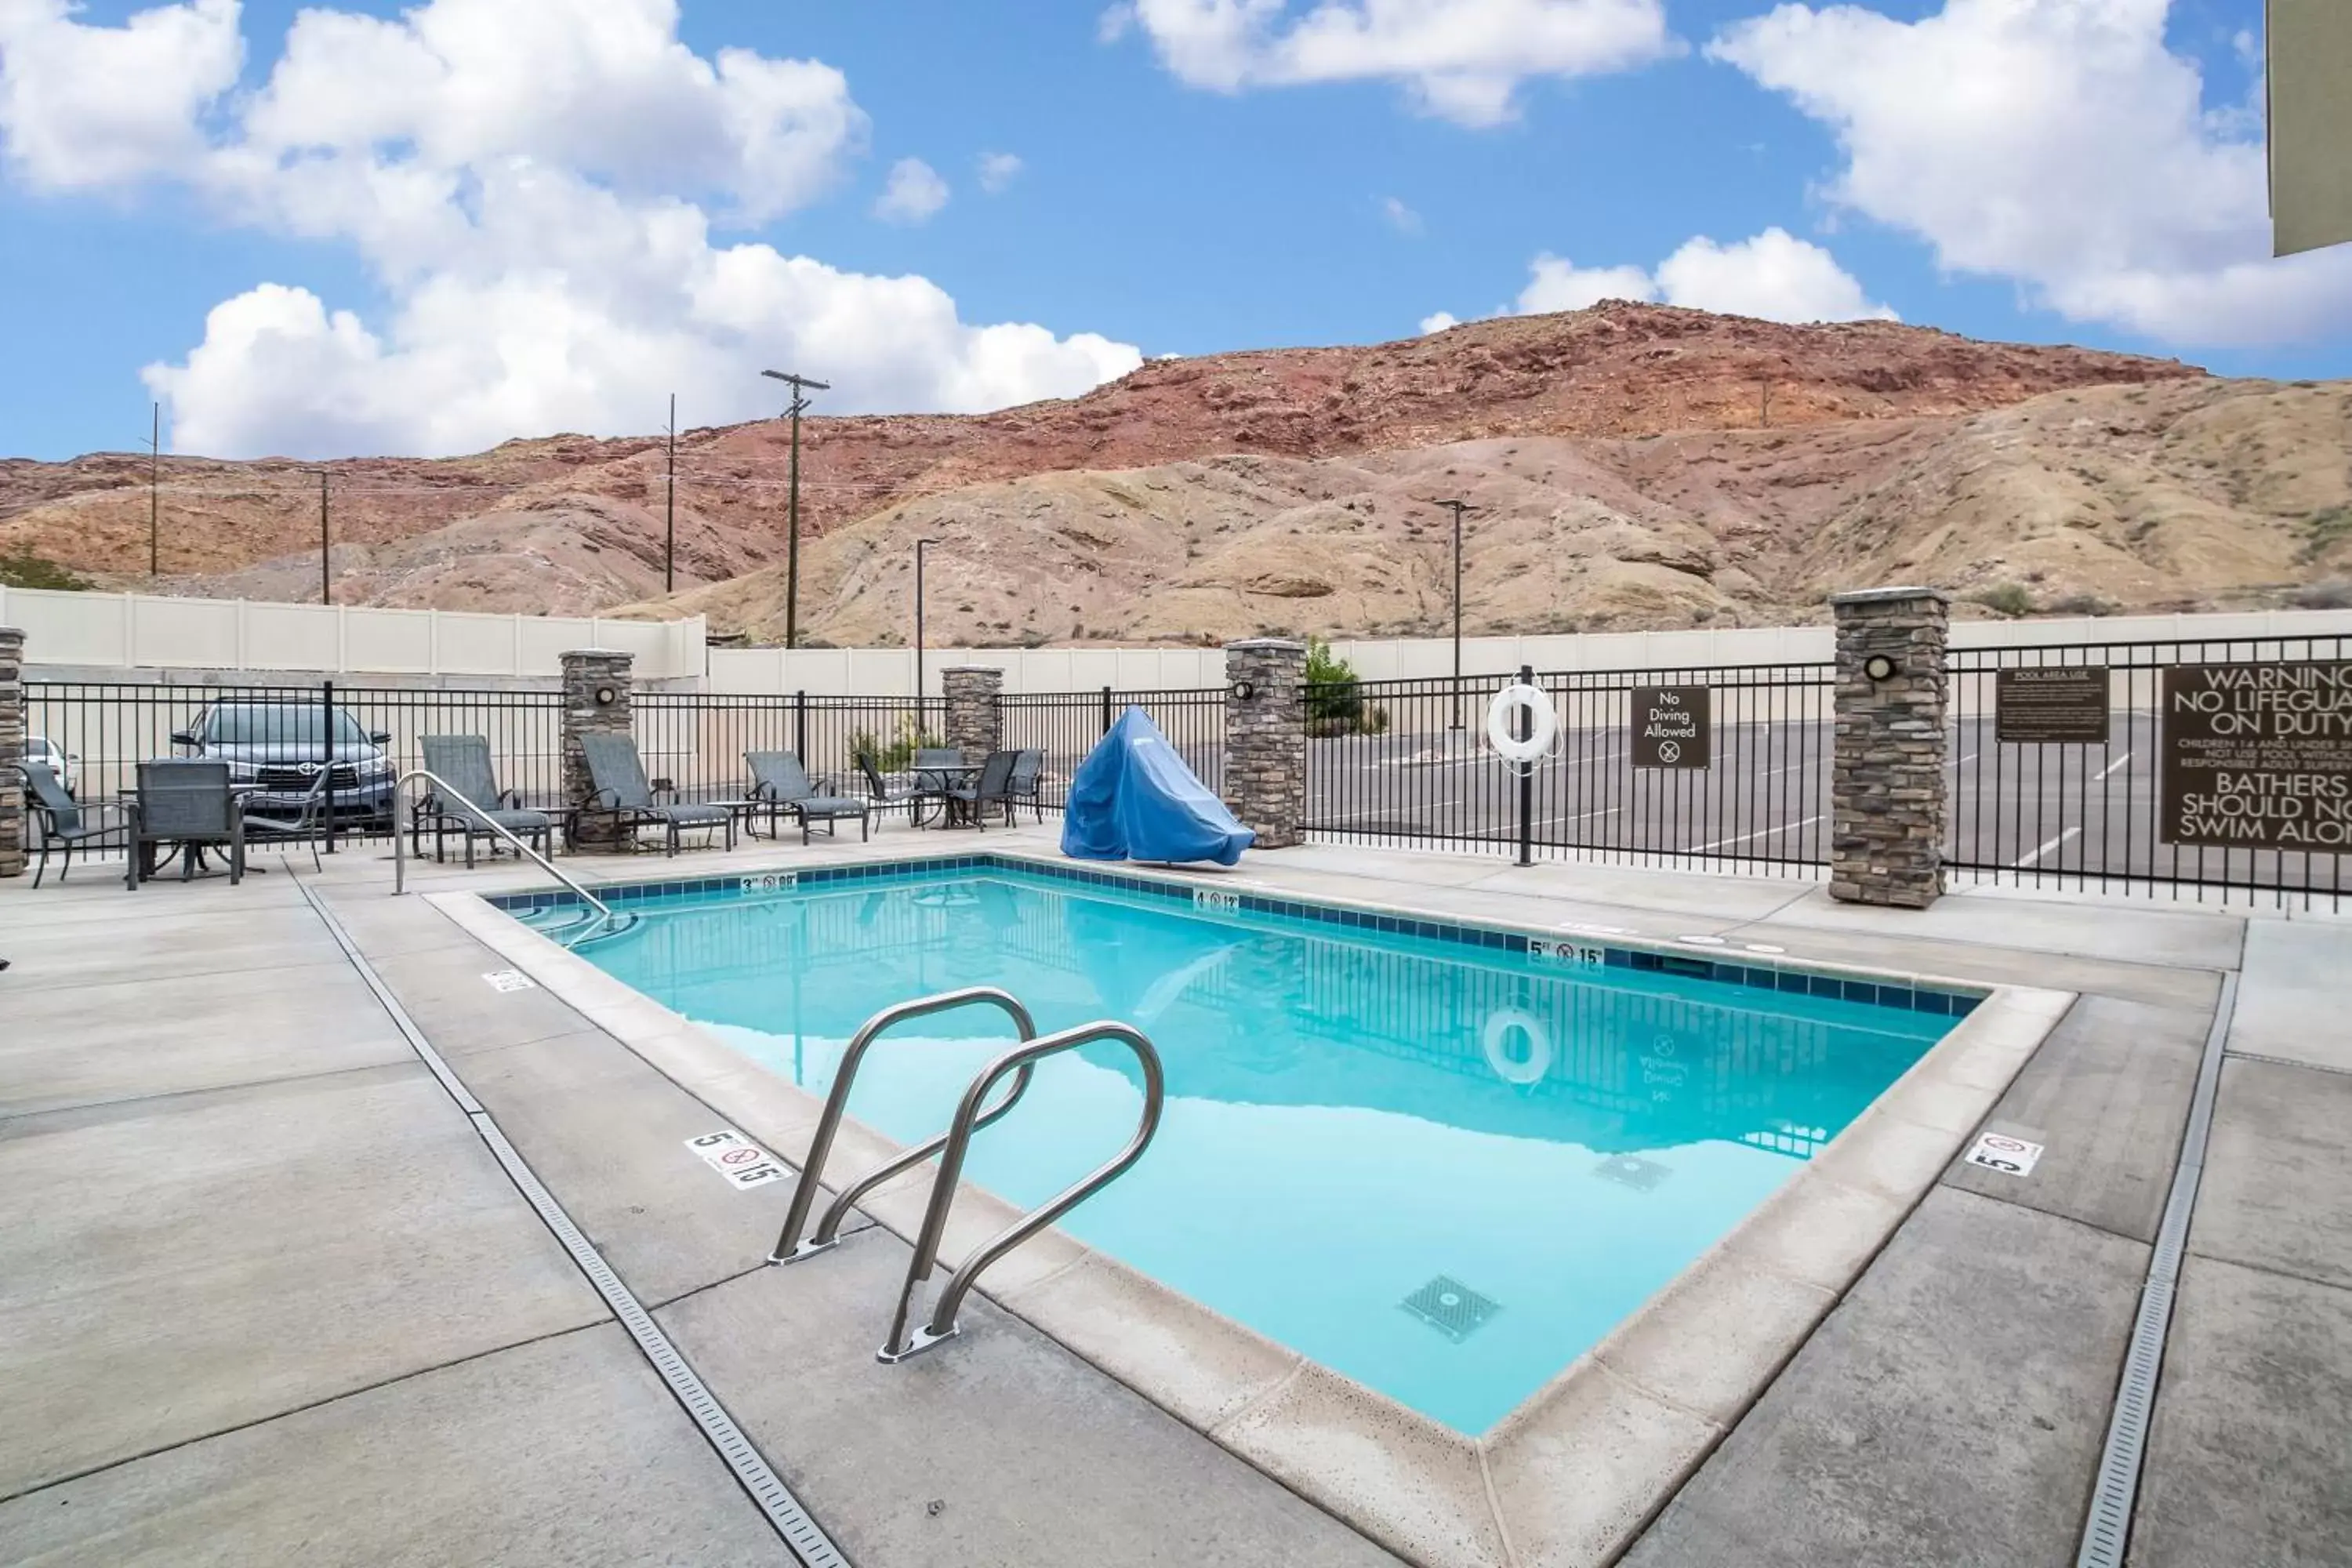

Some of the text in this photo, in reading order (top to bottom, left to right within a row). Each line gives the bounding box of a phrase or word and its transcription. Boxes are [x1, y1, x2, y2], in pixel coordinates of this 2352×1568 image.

[1660, 691, 1680, 705] No
[2174, 690, 2224, 713] NO
[1649, 708, 1690, 725] Diving
[2210, 712, 2352, 735] ON DUTY
[1644, 723, 1696, 738] Allowed
[2258, 739, 2288, 750] AND
[2205, 749, 2231, 759] NOT
[2262, 750, 2296, 760] POOL
[2260, 760, 2301, 770] ADULT
[2216, 771, 2349, 798] BATHERS
[2182, 793, 2303, 818] SHOULD
[2180, 815, 2352, 844] SWIM ALO
[694, 1133, 734, 1147] 5
[1976, 1155, 2021, 1171] 5
